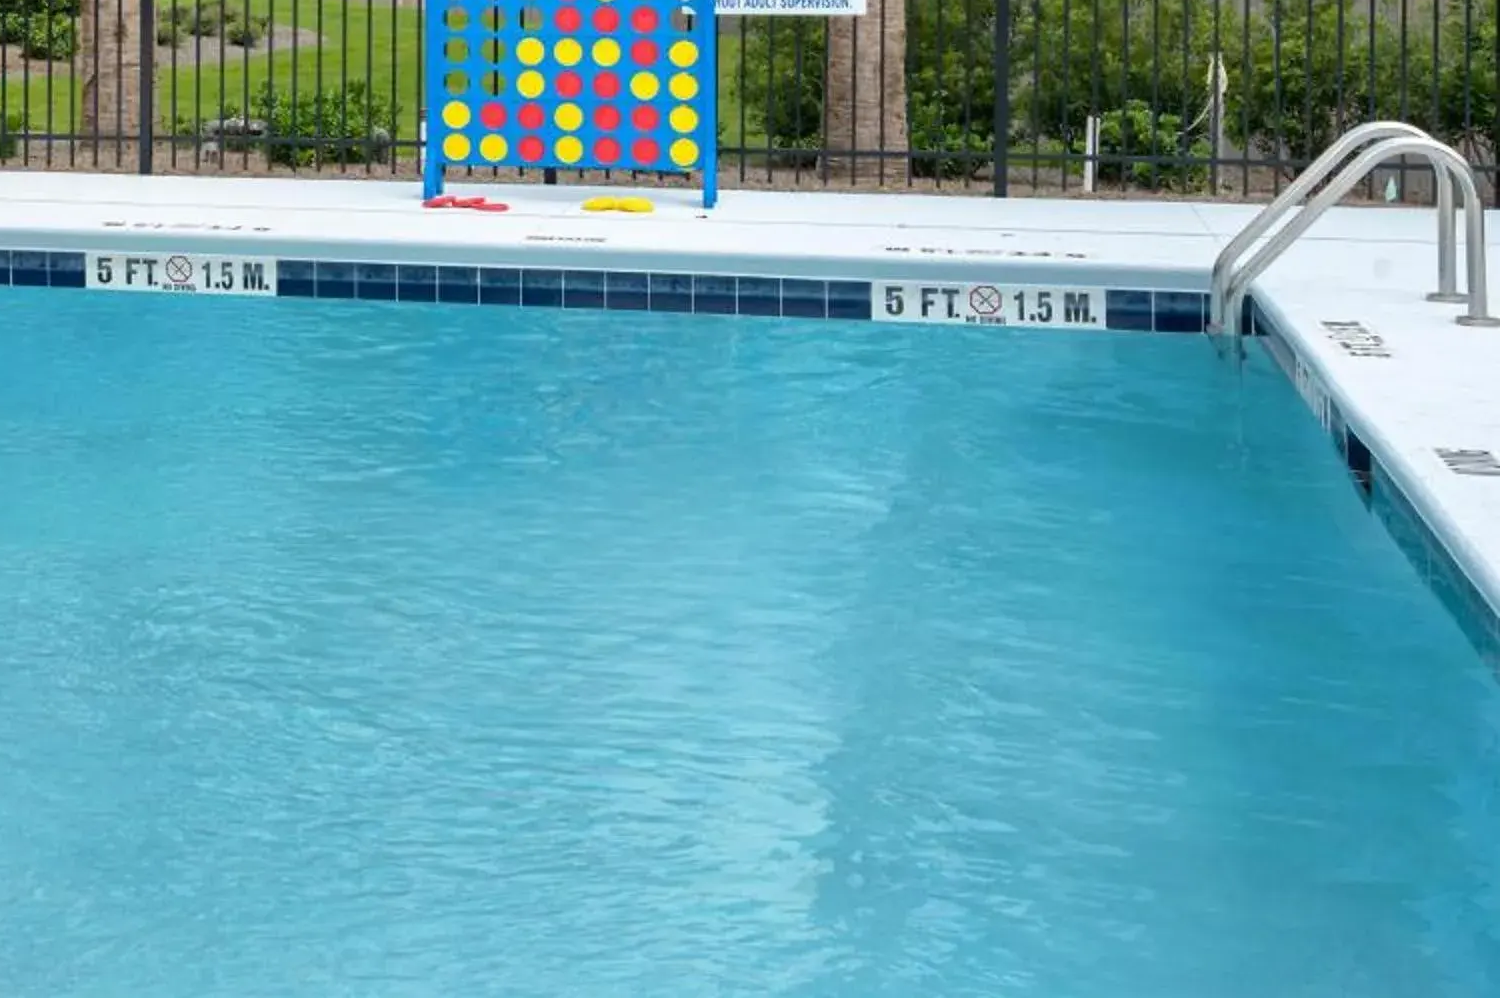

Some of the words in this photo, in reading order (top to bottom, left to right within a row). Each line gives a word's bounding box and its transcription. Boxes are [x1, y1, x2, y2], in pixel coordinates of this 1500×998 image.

[97, 257, 113, 285] 5
[125, 257, 159, 287] FT.
[202, 260, 235, 290] 1.5
[242, 261, 271, 291] M.
[885, 286, 905, 317] 5
[920, 287, 961, 319] FT.
[1013, 290, 1053, 323] 1.5
[1063, 291, 1098, 324] M.
